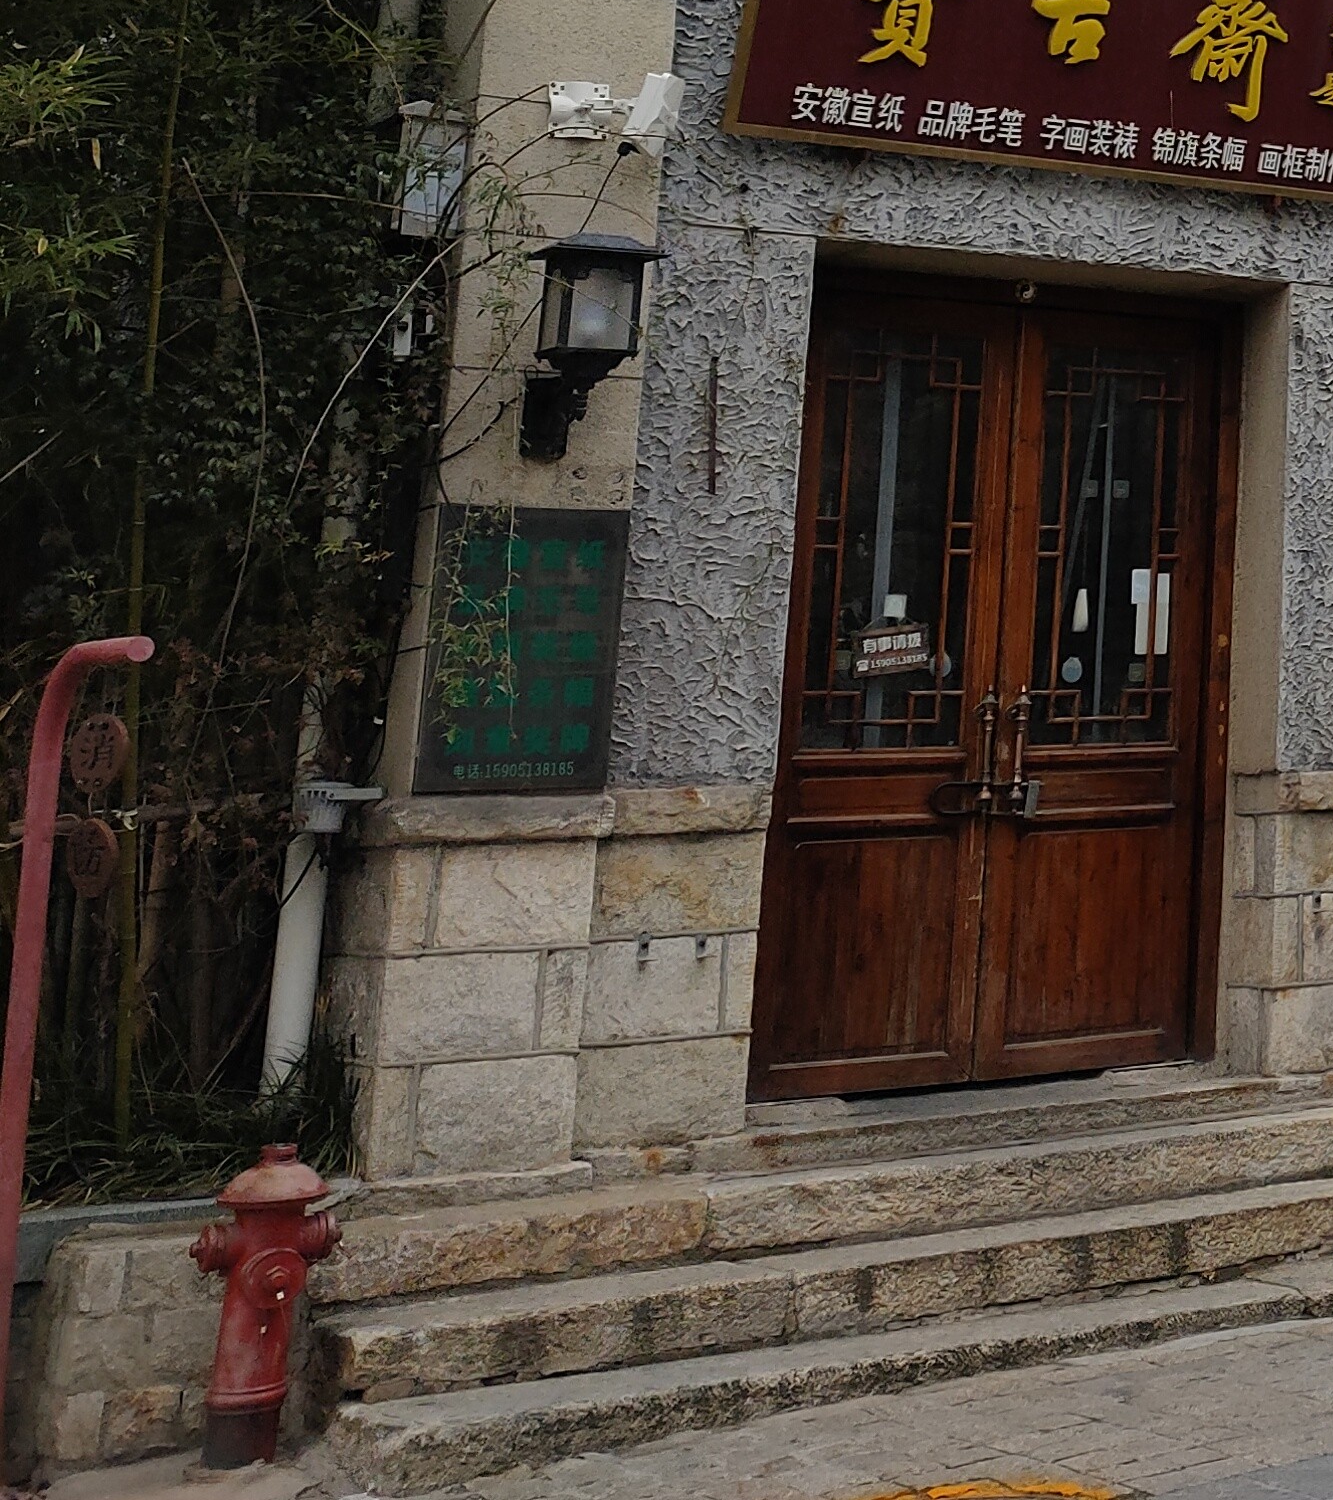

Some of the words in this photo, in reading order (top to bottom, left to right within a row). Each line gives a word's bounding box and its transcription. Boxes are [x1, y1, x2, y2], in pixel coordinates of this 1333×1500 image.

[793, 83, 903, 134] 安徽宣纸
[917, 100, 1026, 148] 品牌毛笔
[1039, 114, 1140, 161] 字画装裱
[1152, 128, 1245, 172] 锦旗条幅
